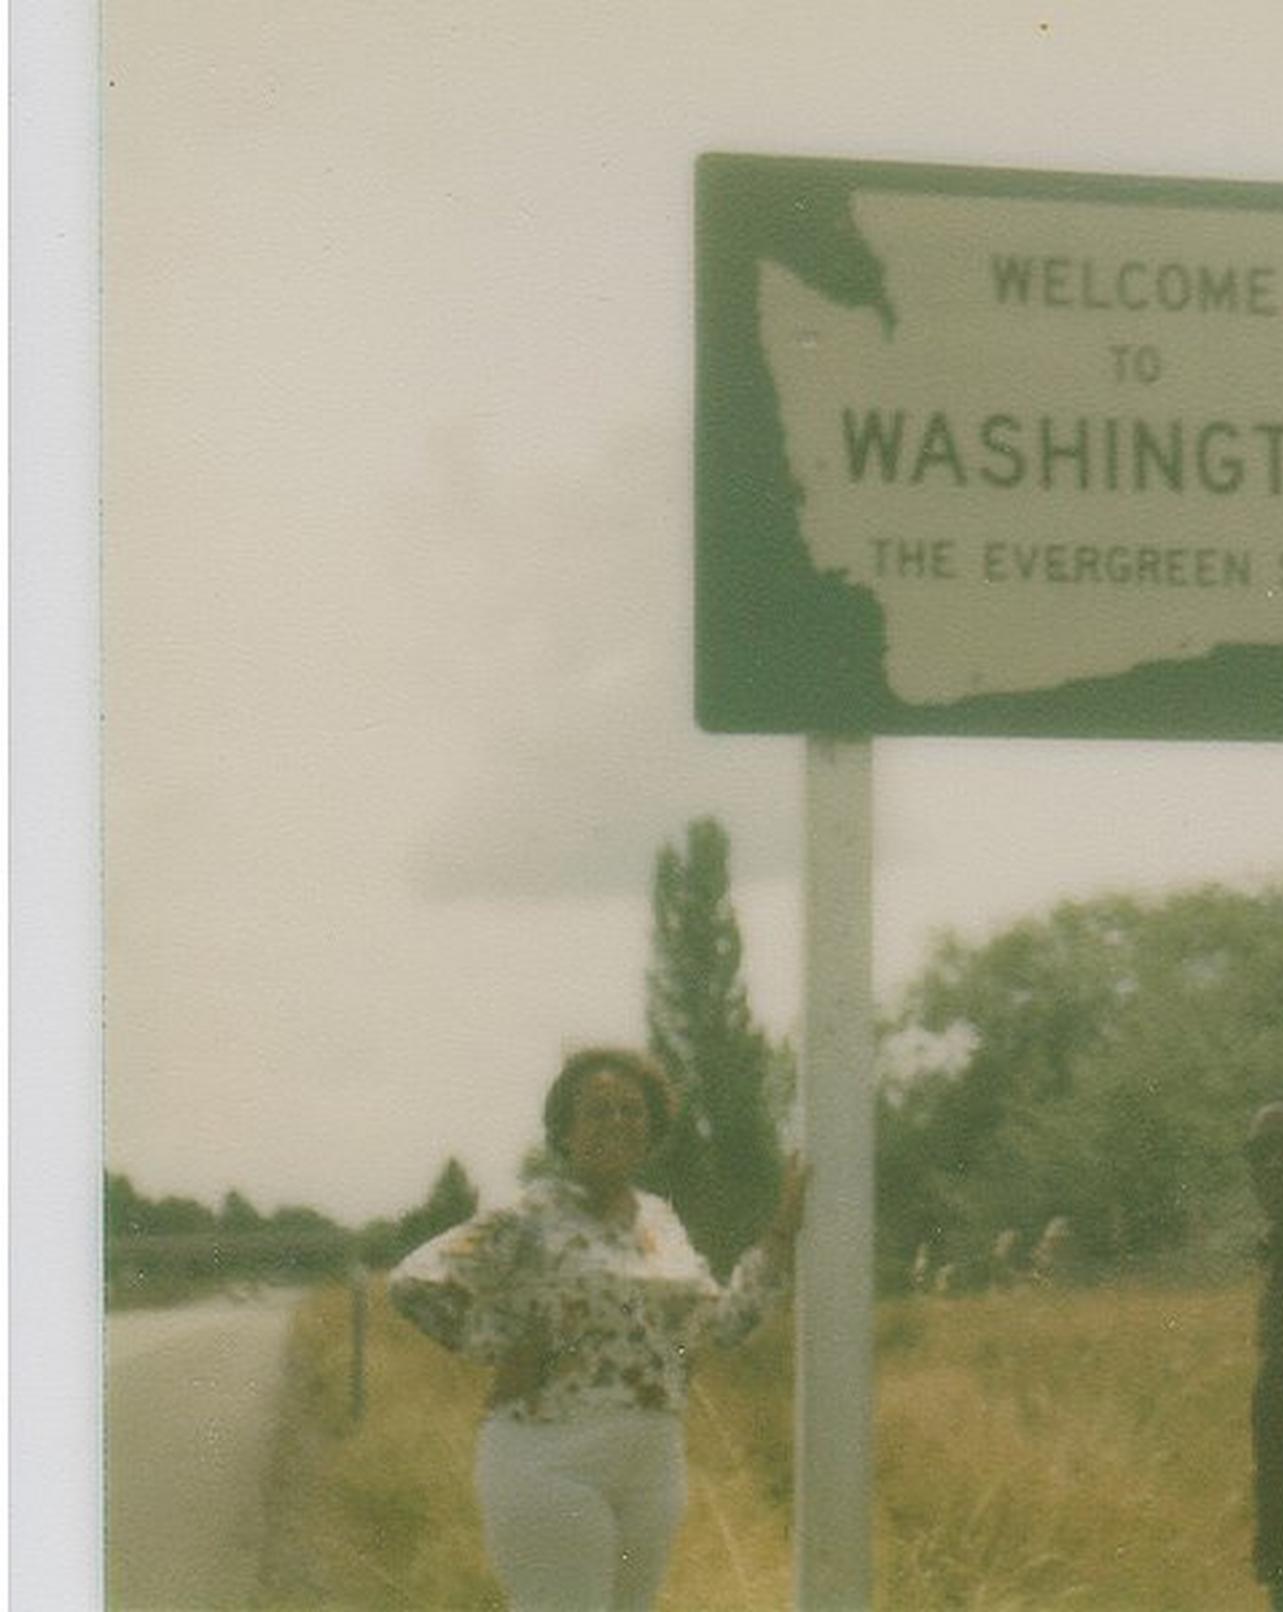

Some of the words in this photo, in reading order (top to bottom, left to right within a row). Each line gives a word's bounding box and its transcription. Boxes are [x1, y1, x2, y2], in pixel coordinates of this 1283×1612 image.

[991, 254, 1277, 317] WELCOME
[1109, 344, 1162, 385] TO
[870, 538, 956, 581] THE
[983, 543, 1251, 589] EVERGREEN
